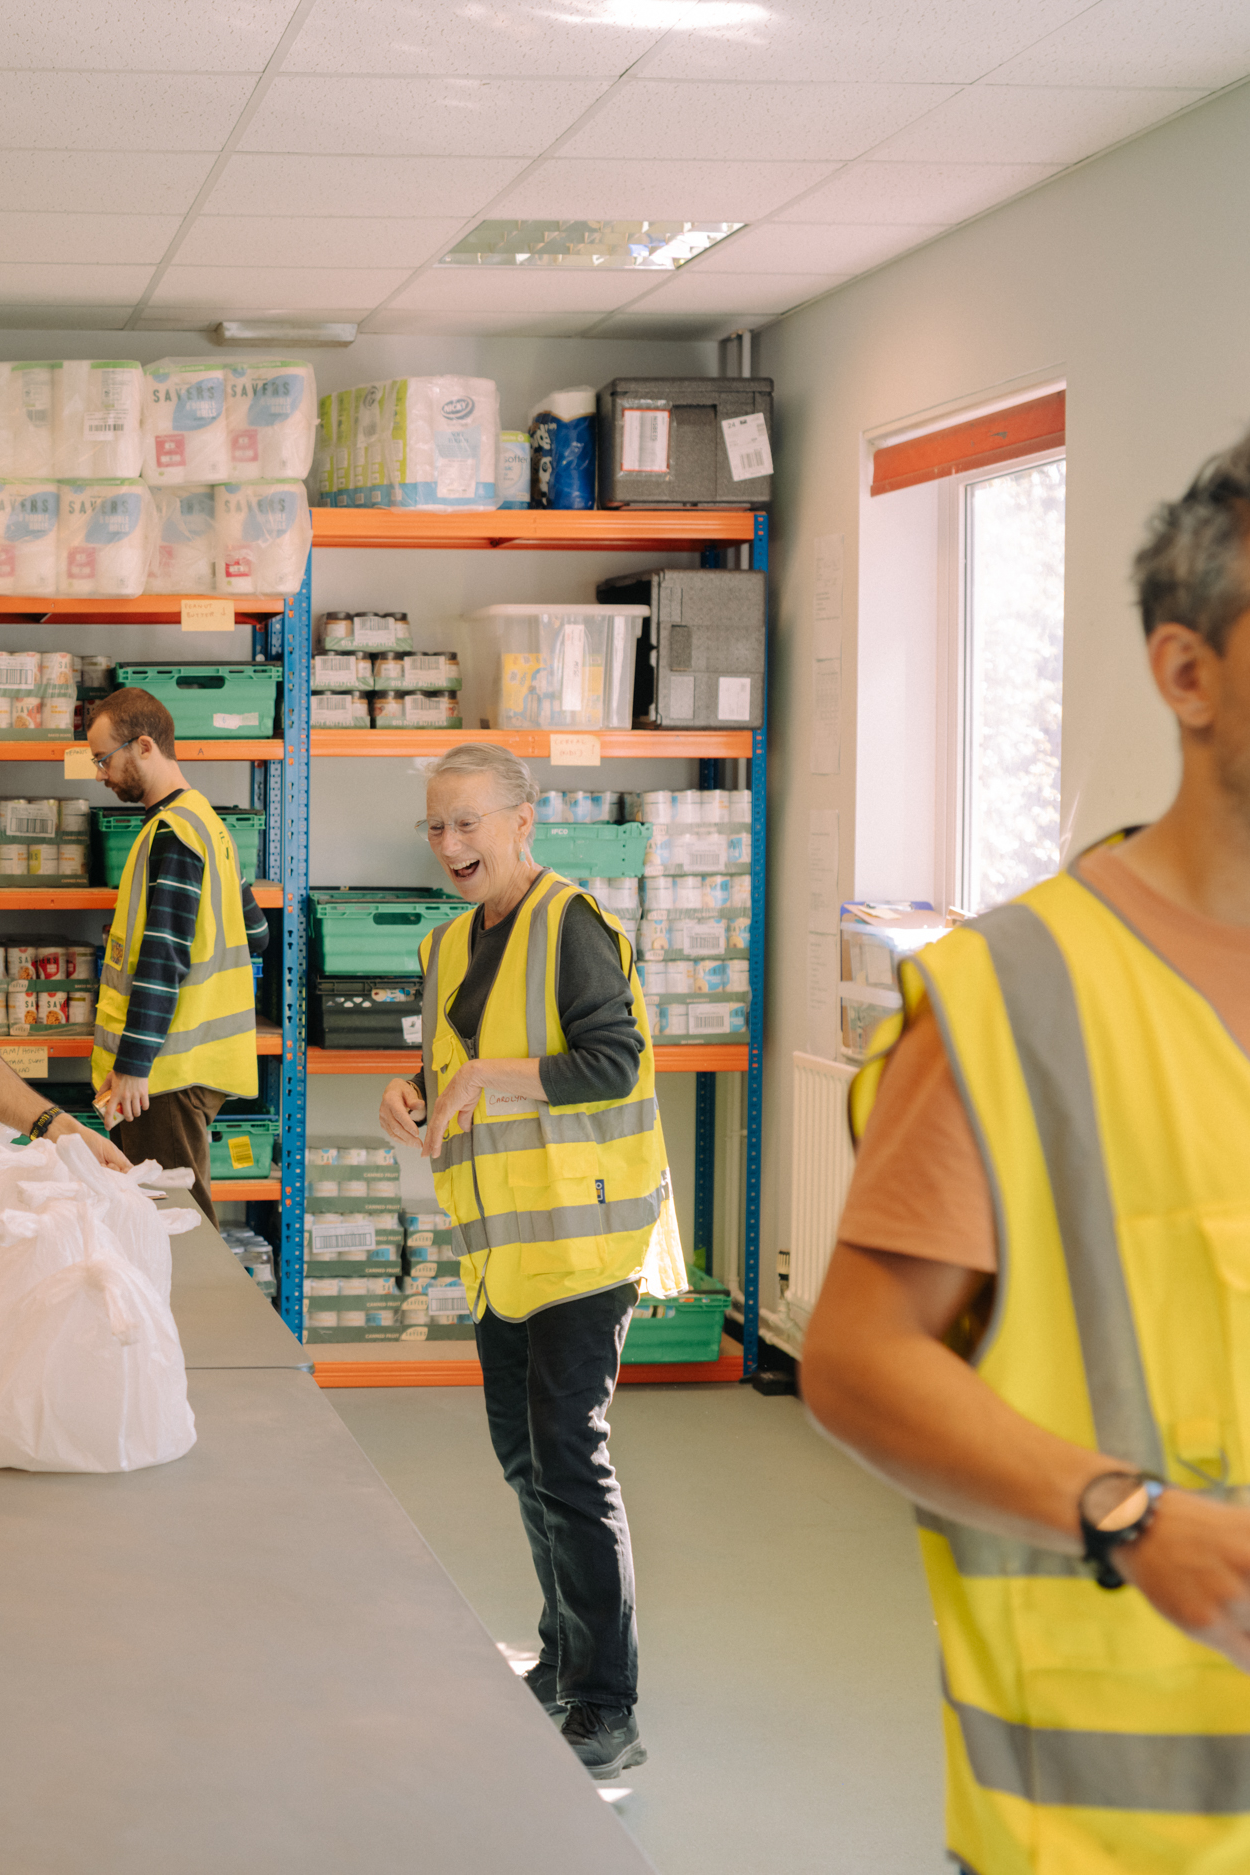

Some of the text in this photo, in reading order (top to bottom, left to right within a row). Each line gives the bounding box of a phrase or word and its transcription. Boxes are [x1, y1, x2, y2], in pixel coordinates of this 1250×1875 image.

[153, 386, 215, 403] SAVERS
[231, 382, 291, 398] SAVERS
[68, 500, 130, 515] SAVERS
[488, 1094, 528, 1106] CAROLYN
